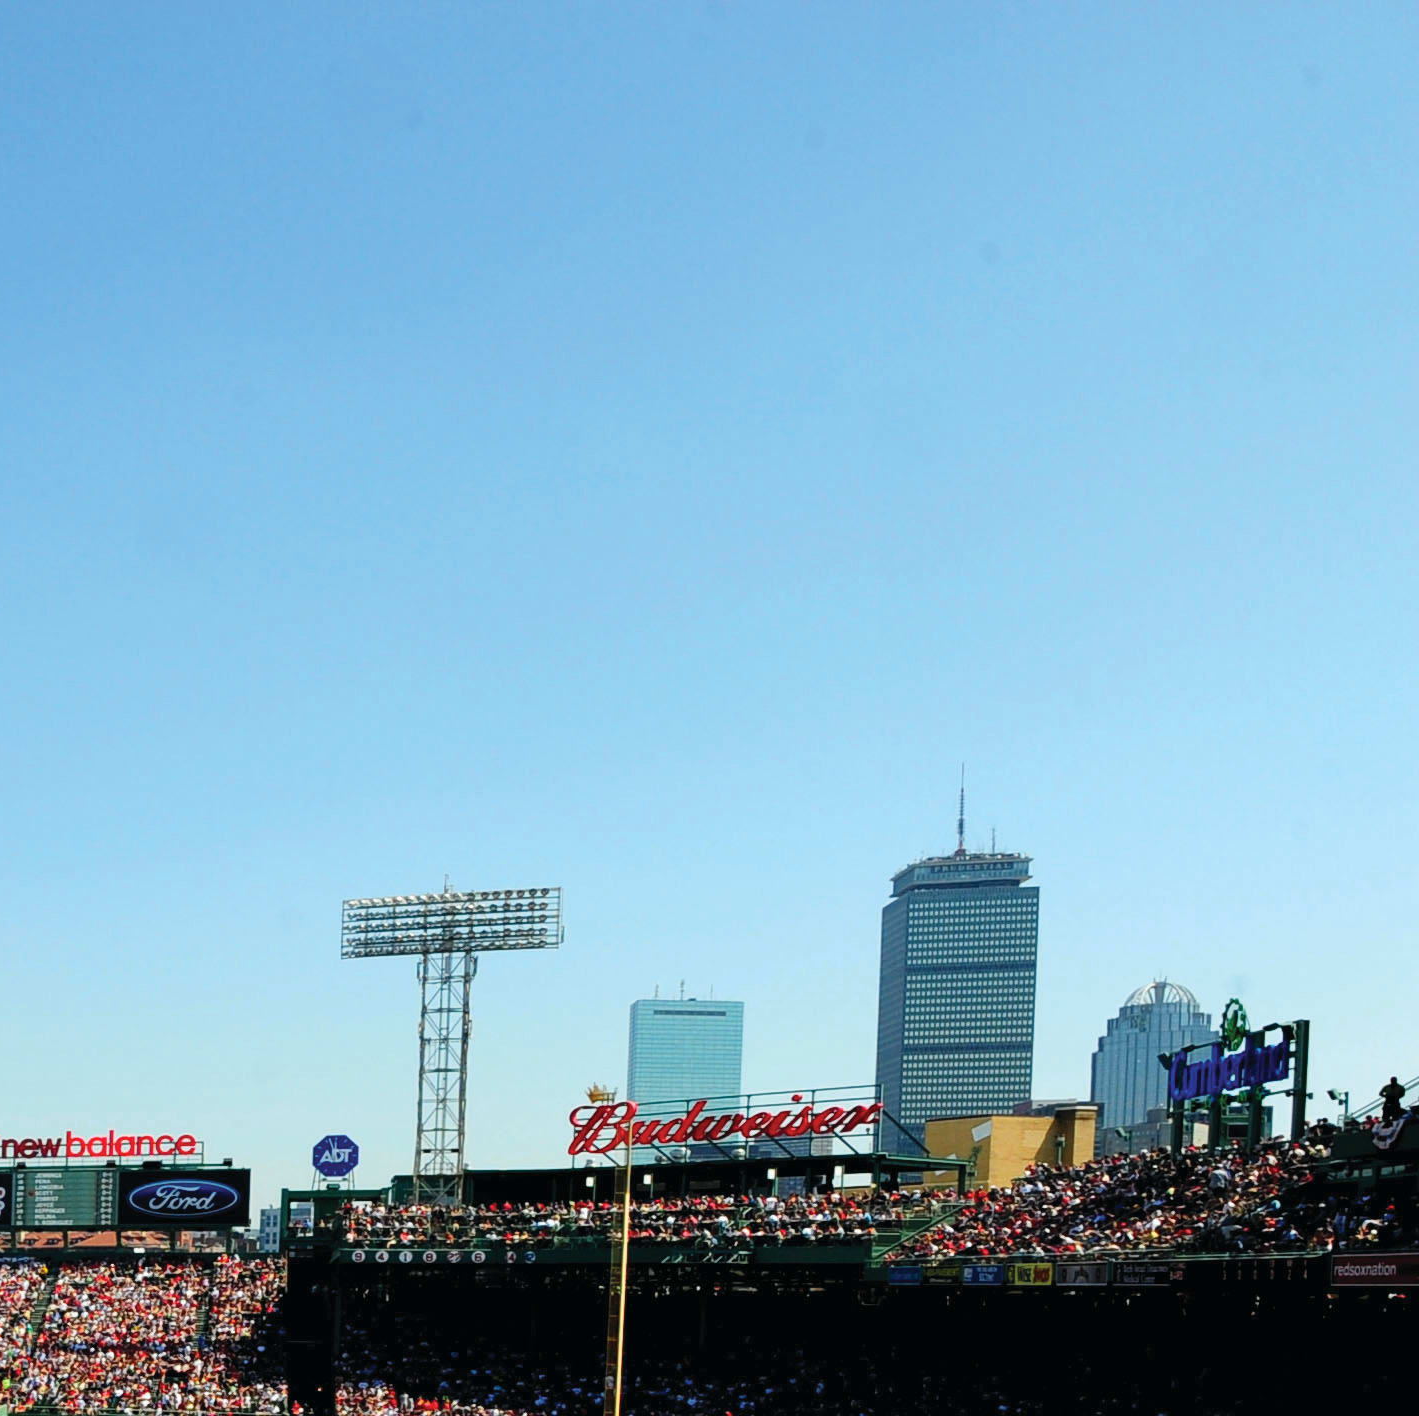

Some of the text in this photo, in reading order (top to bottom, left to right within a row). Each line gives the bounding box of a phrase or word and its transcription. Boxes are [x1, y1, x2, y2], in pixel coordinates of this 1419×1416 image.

[568, 1093, 884, 1155] Budweiser
[2, 1130, 197, 1158] new balance
[320, 1148, 352, 1163] ADT
[148, 1184, 216, 1212] Ford
[1333, 1263, 1397, 1278] redsoxnation
